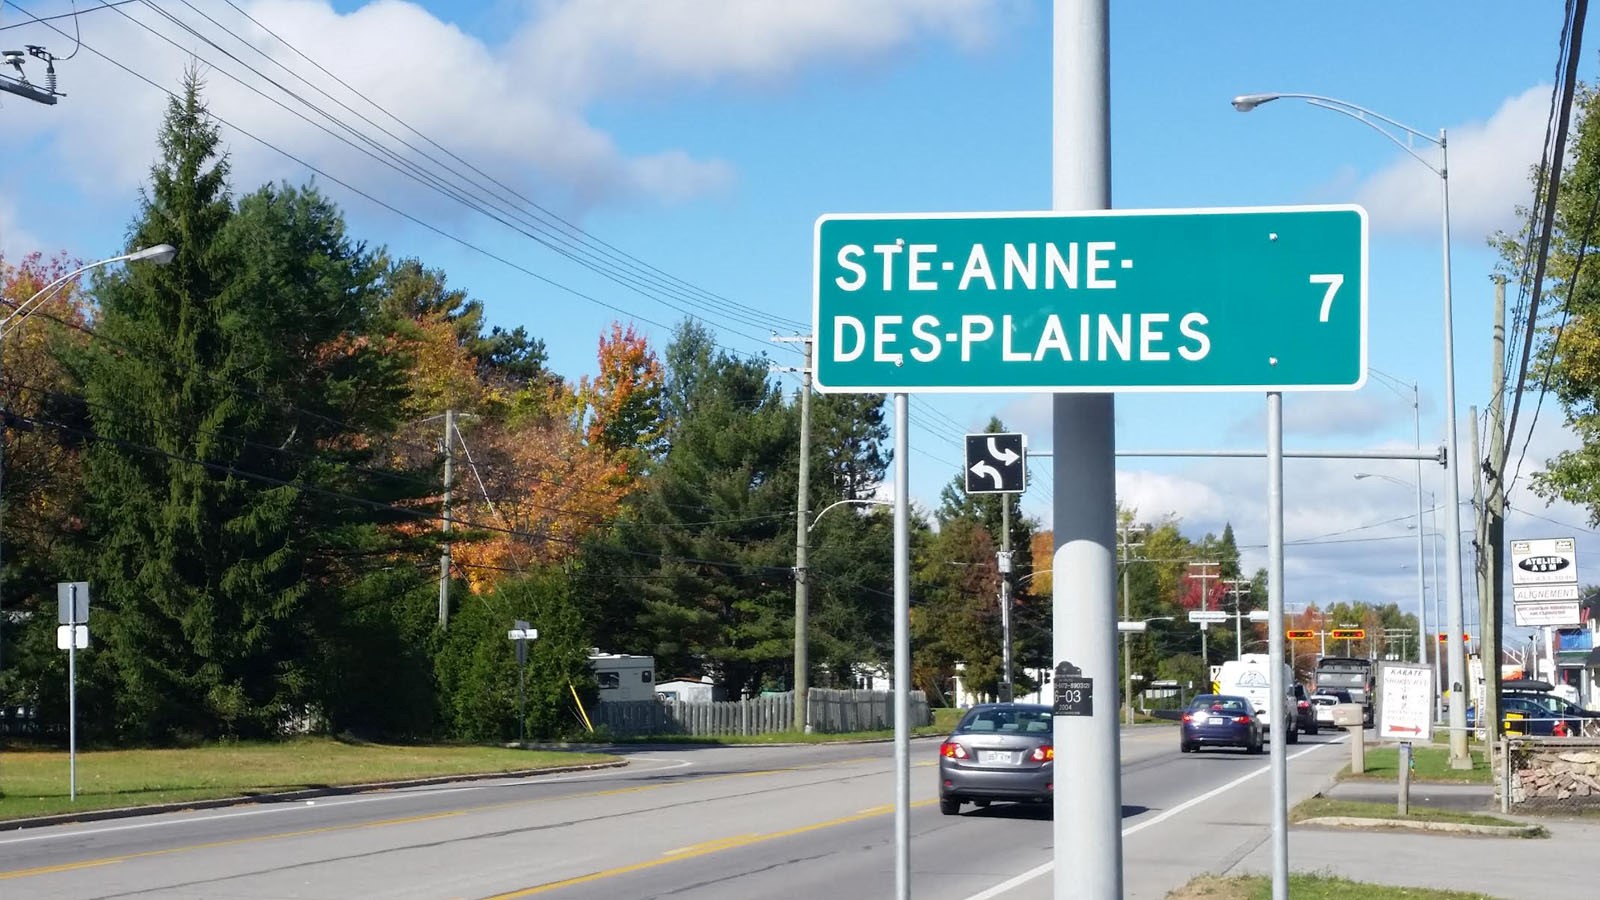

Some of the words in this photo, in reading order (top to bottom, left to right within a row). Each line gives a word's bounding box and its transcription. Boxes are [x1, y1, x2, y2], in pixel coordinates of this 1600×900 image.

[835, 241, 1134, 292] STE-ANNE-
[1309, 273, 1345, 323] 7
[833, 312, 1212, 363] DES-PLAINES
[1525, 557, 1563, 566] ATELIER
[1517, 588, 1575, 600] ALIGNEMENT
[1390, 669, 1424, 677] KARATE
